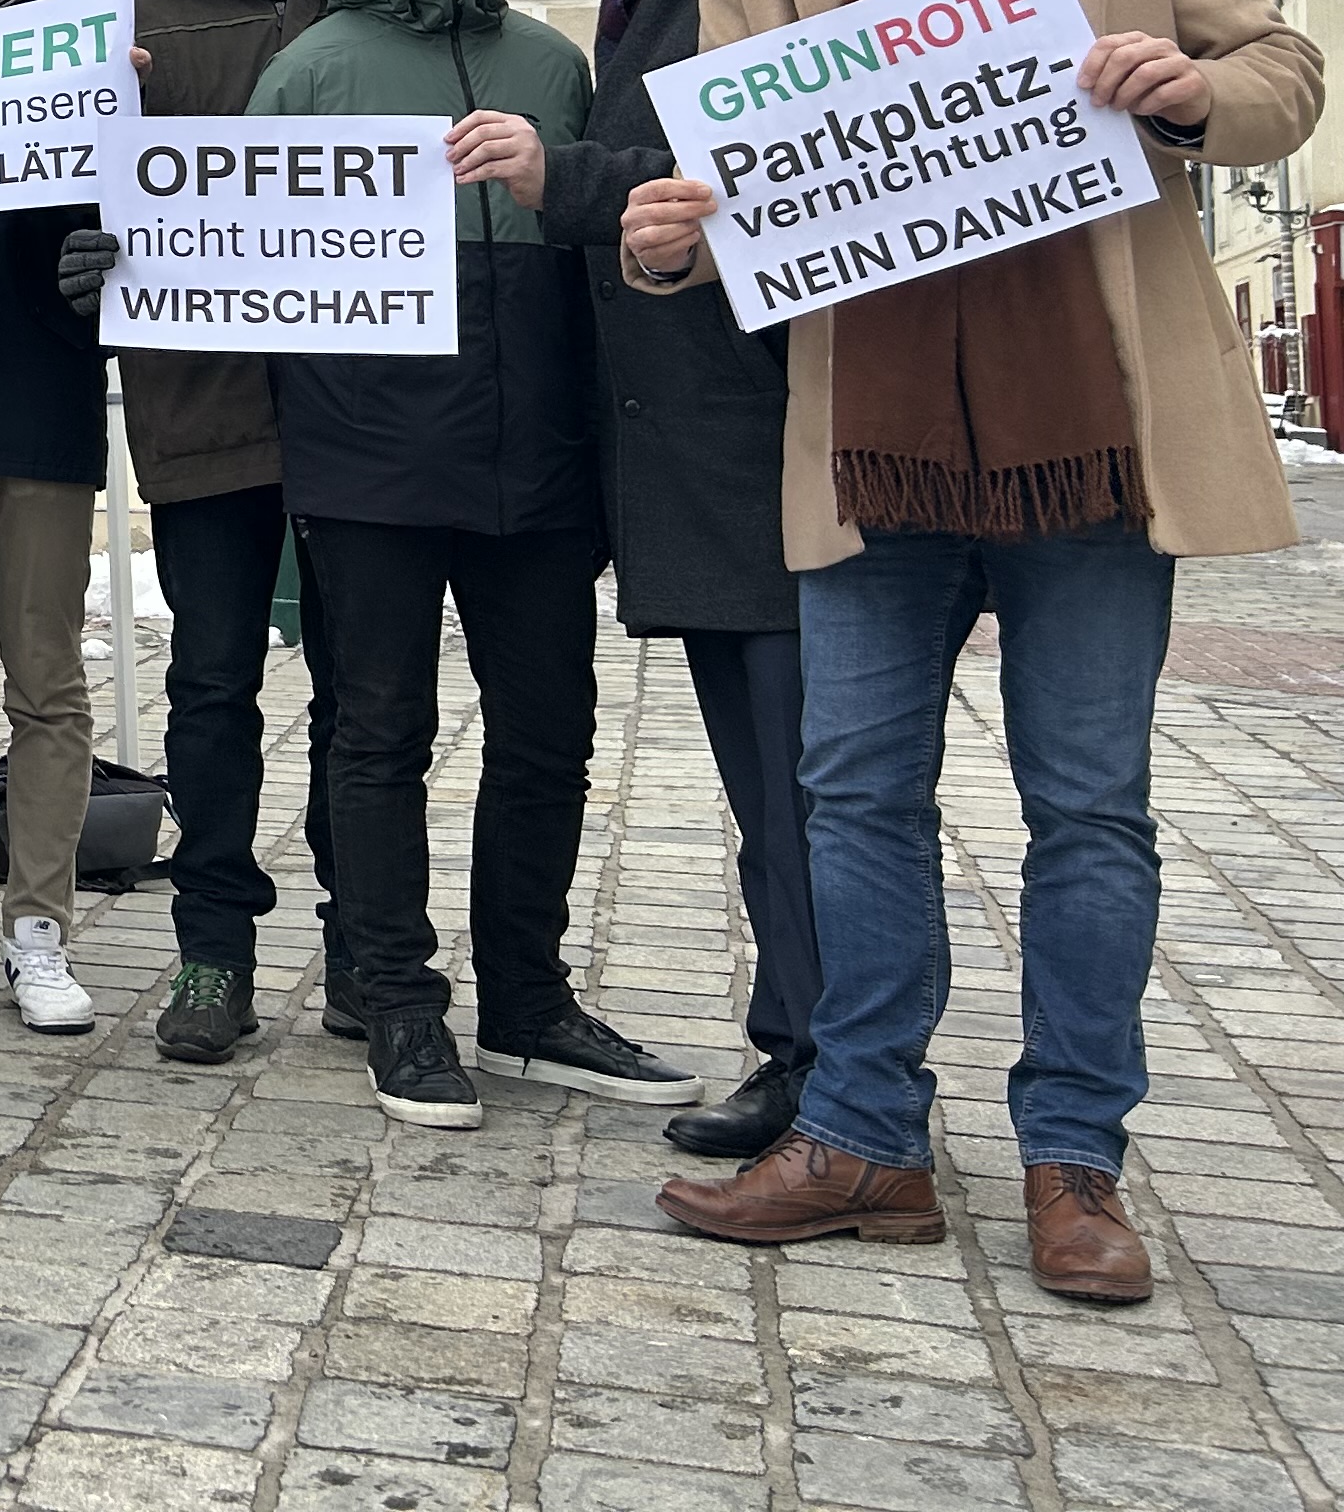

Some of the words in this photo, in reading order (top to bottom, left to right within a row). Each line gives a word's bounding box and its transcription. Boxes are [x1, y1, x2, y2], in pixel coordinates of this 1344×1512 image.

[136, 145, 419, 197] OPFERT
[710, 56, 1074, 198] Parkplatz-
[730, 99, 1087, 238] vernichtung
[126, 218, 245, 257] nicht
[260, 228, 425, 258] unsere
[753, 231, 897, 310] NEIN
[901, 157, 1124, 263] DANKE!
[120, 286, 434, 325] WIRTSCHAFT
